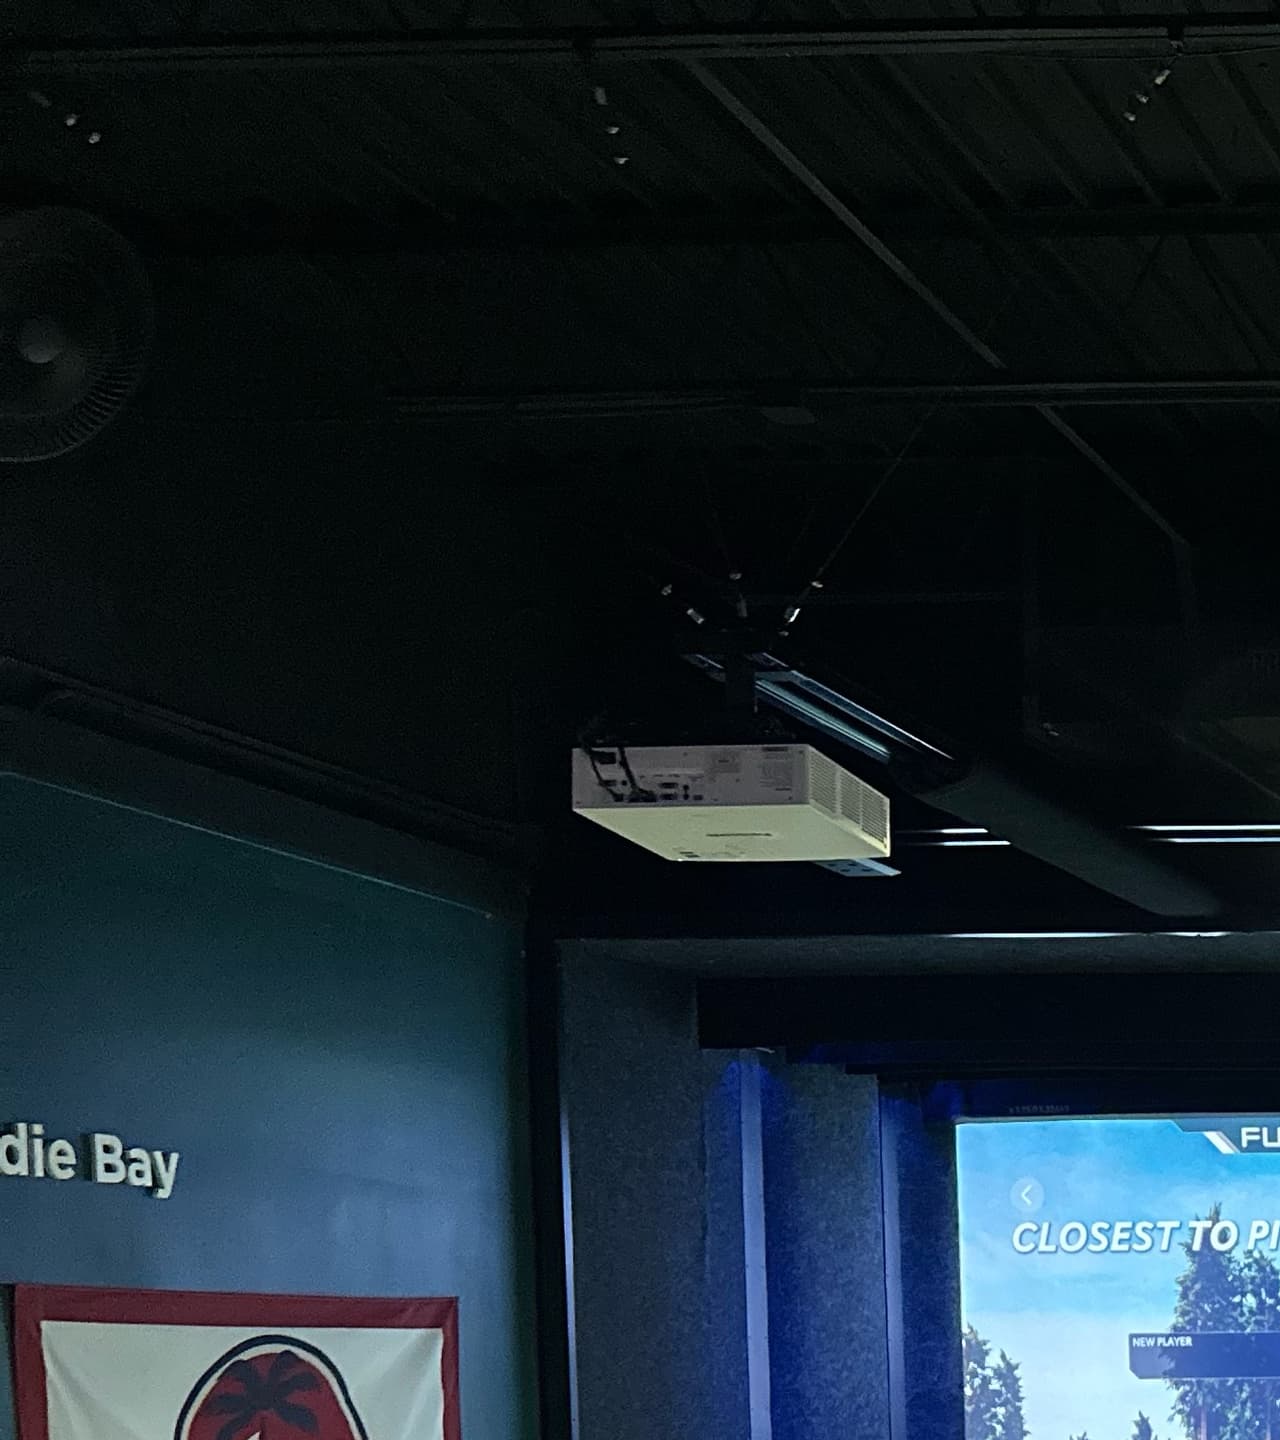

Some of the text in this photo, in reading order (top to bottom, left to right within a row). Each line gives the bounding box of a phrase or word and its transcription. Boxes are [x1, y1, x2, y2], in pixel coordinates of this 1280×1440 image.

[0, 1122, 179, 1199] die Bay
[1012, 1219, 1181, 1253] CLOSEST
[1187, 1219, 1239, 1251] TO
[1132, 1335, 1193, 1348] NEW PLAYER
